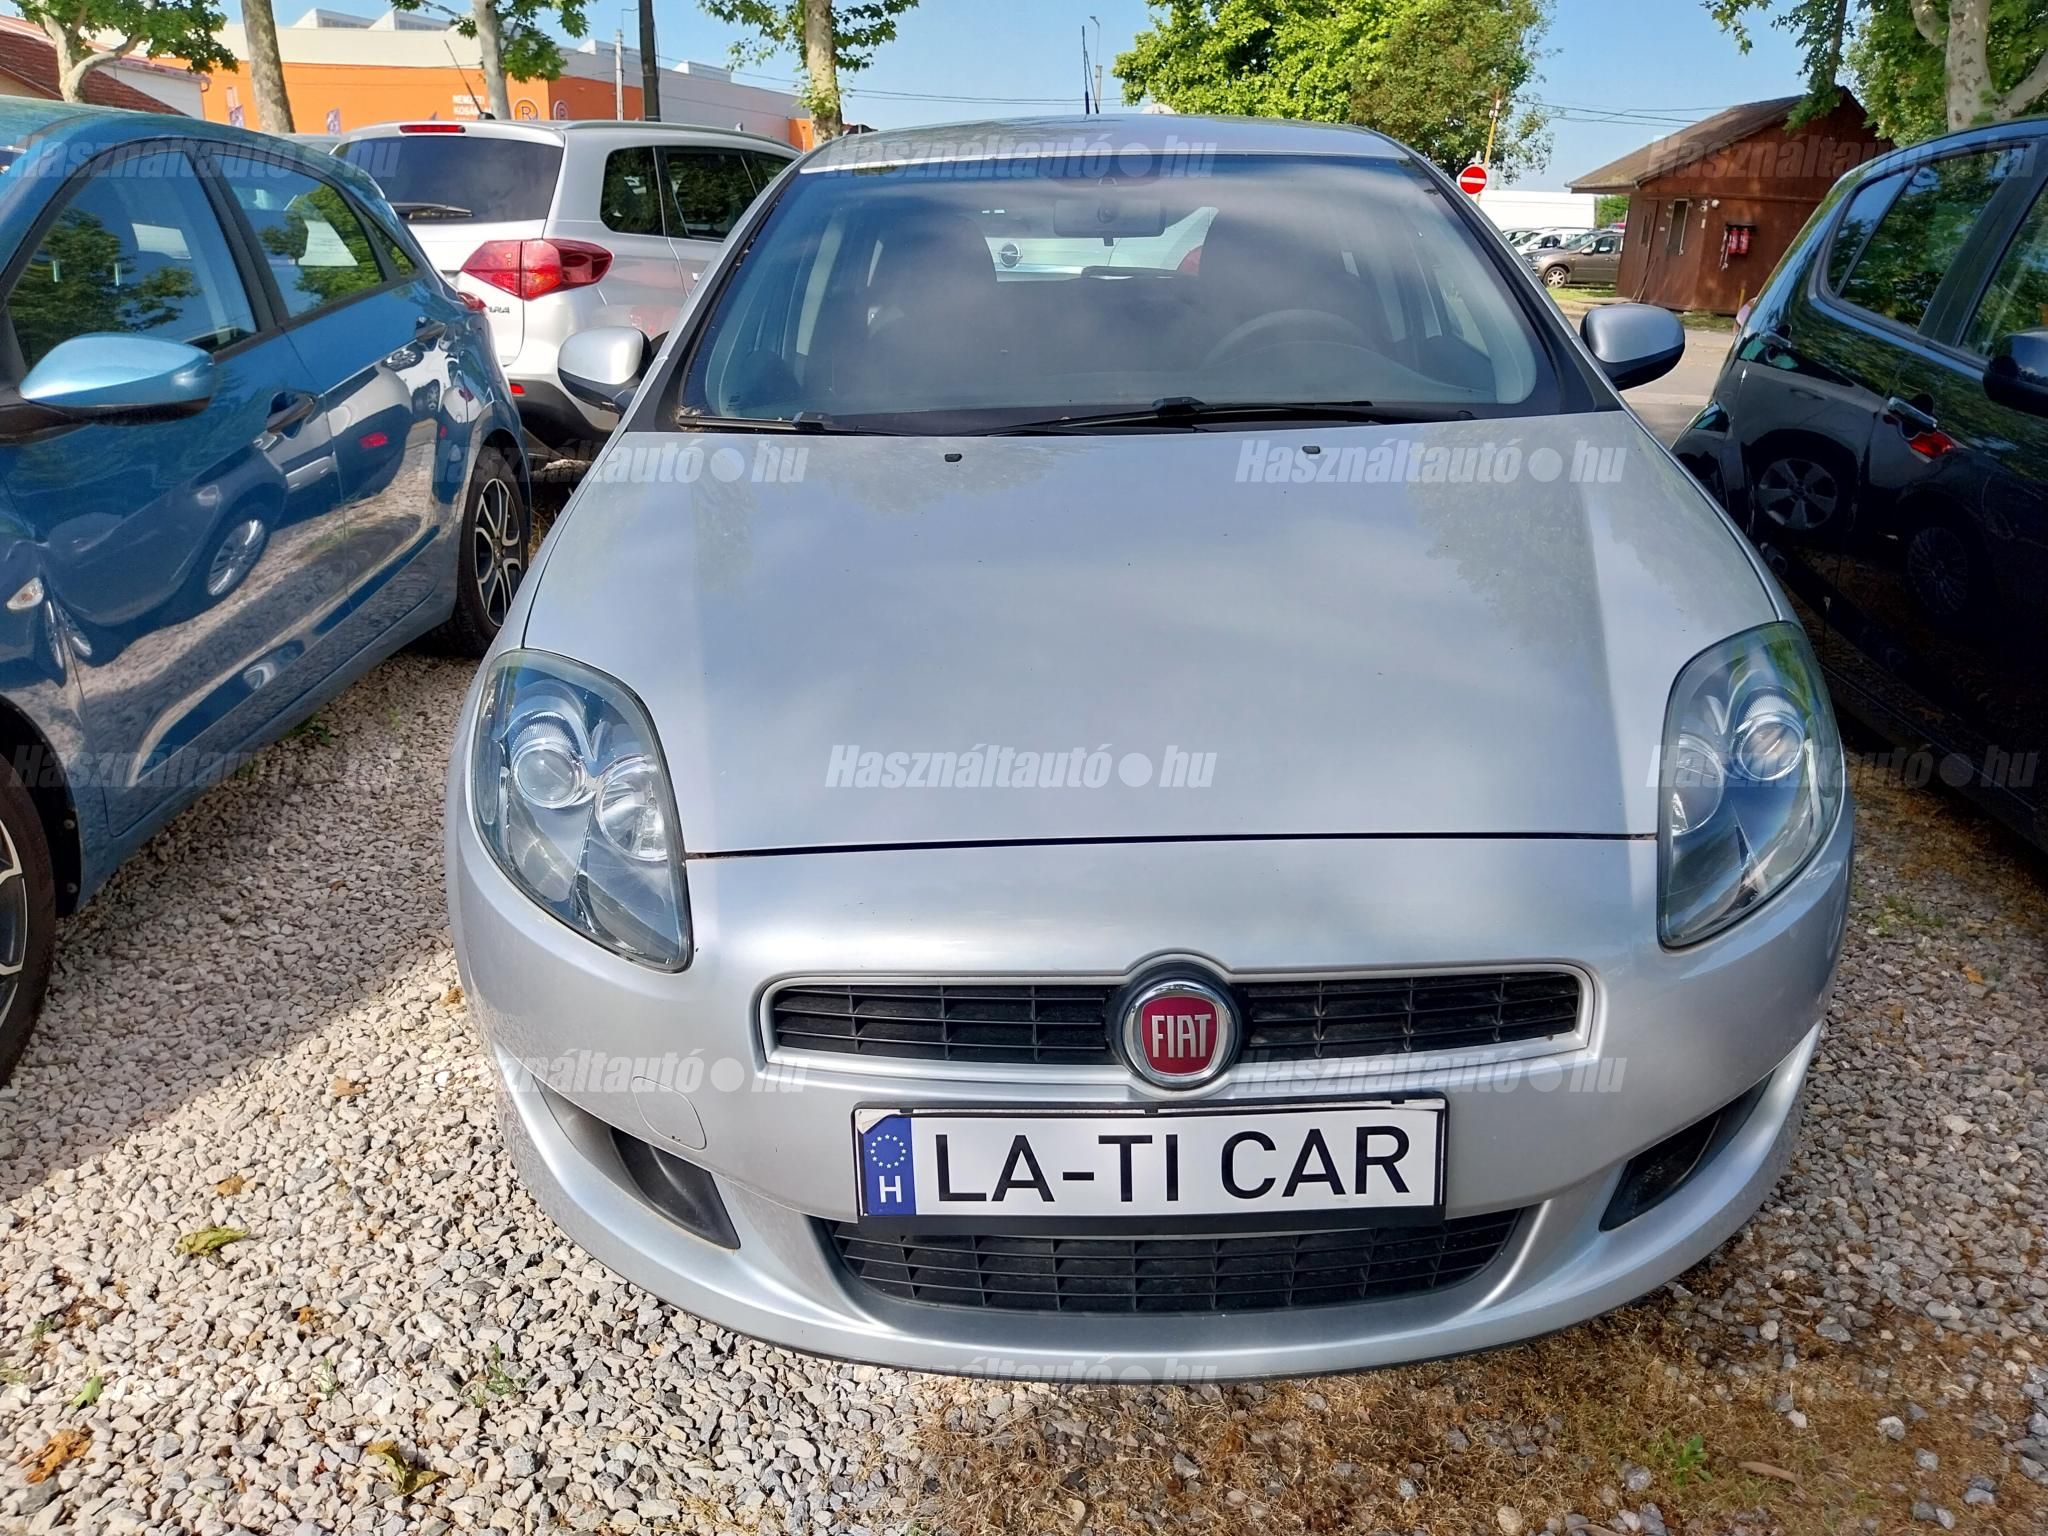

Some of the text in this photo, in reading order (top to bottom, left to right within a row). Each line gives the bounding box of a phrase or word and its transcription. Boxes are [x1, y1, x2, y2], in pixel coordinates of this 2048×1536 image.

[1150, 1012, 1213, 1060] FIAT
[934, 1125, 1411, 1204] LA-TI CAR
[878, 1175, 903, 1204] H
